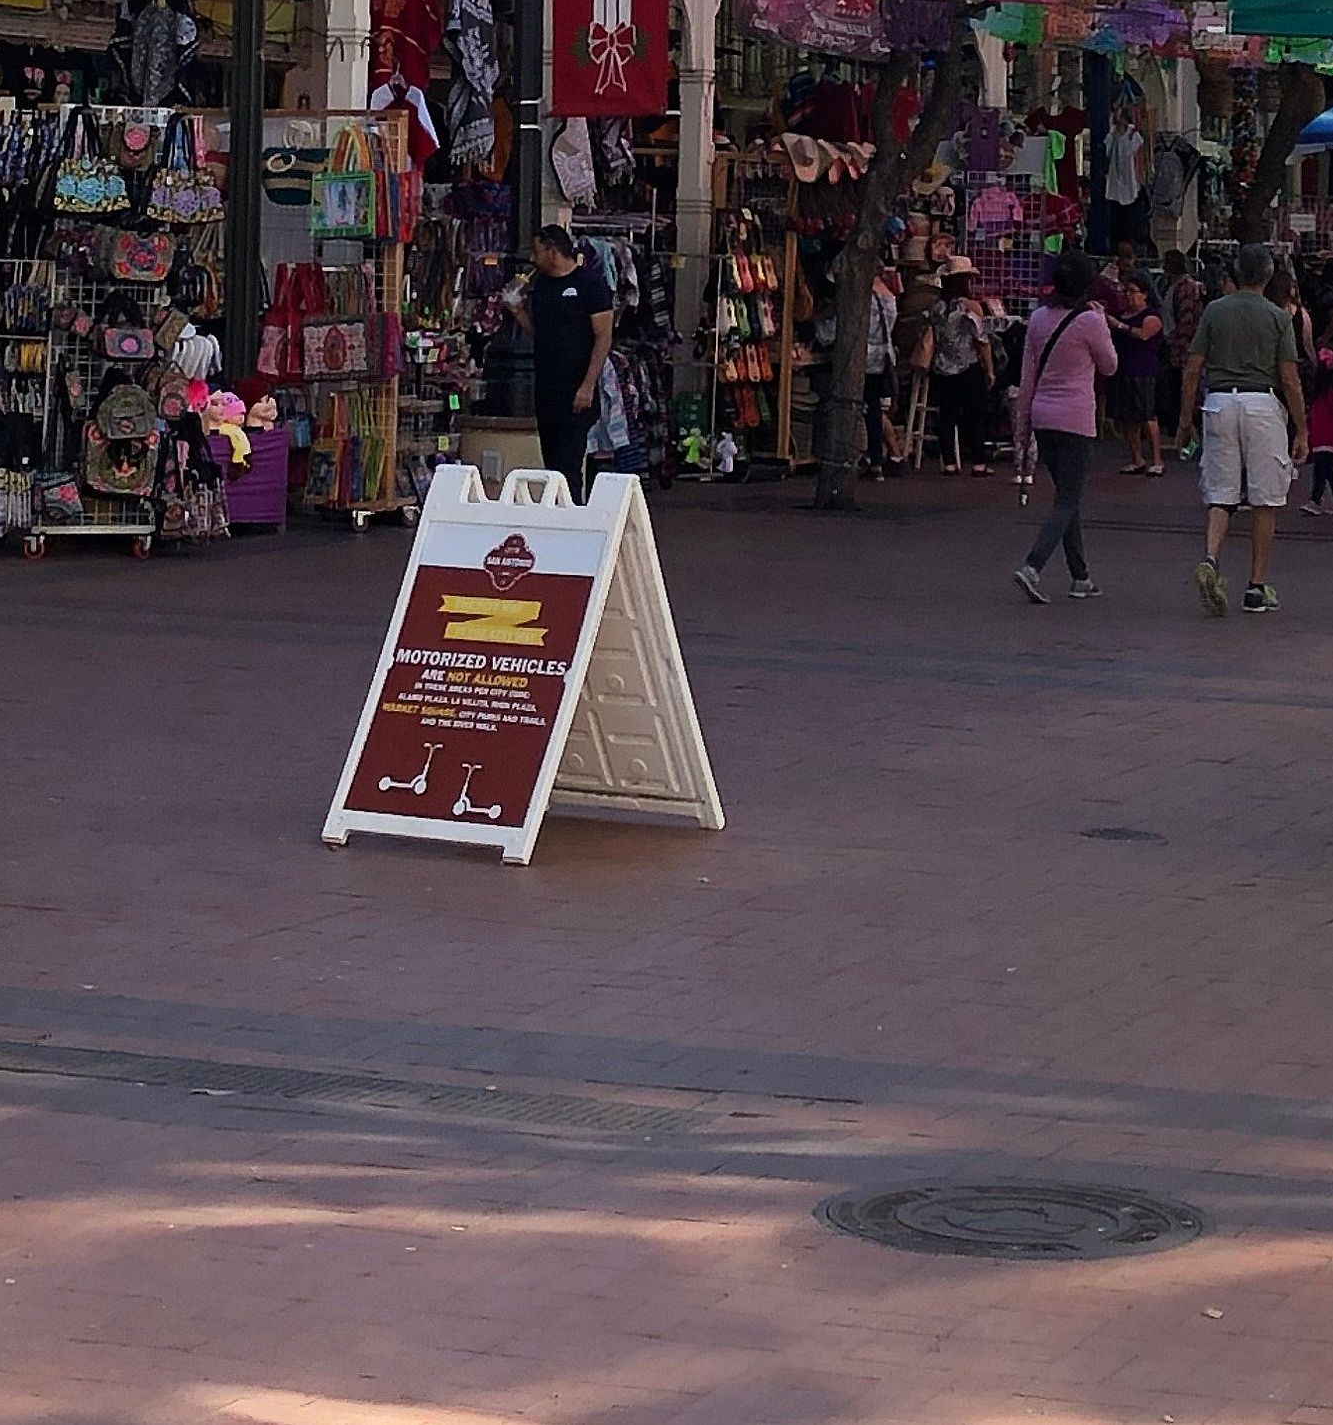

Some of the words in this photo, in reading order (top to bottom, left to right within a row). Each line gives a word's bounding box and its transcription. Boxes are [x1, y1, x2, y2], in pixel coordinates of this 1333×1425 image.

[395, 648, 487, 669] MOTORIZED
[492, 656, 567, 675] VEHICLES
[421, 669, 446, 681] ARE
[446, 671, 472, 683] NOT
[473, 674, 528, 687] ALLOWED
